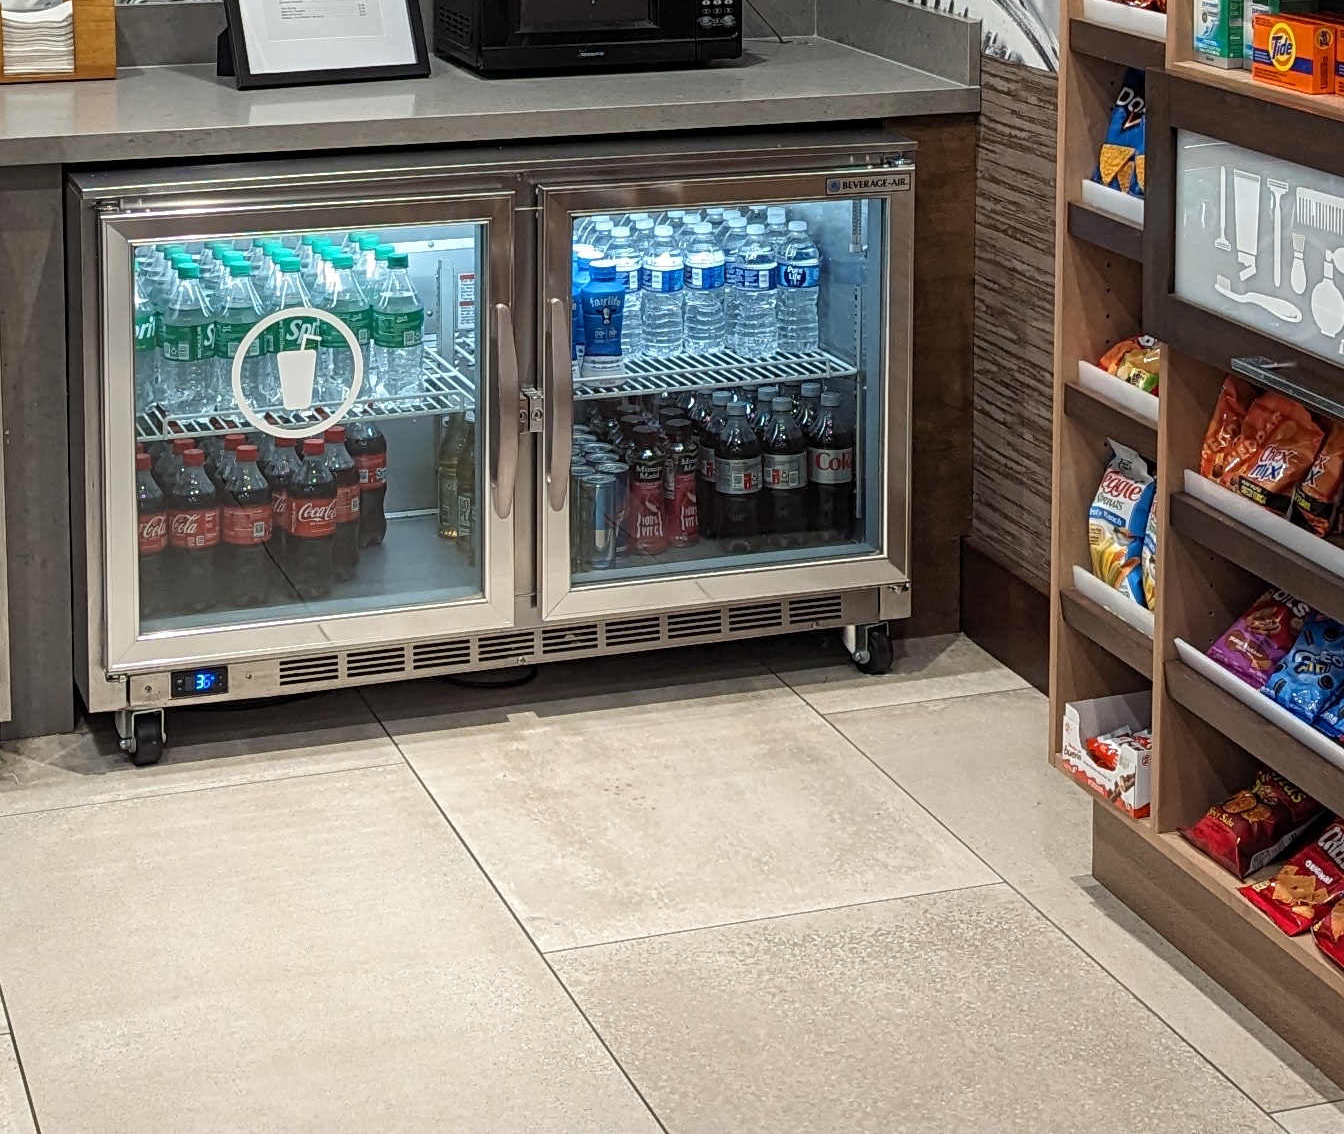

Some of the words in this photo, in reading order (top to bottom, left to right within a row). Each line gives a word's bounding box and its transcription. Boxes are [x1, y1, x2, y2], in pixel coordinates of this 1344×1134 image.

[1271, 34, 1293, 59] Tide
[843, 178, 906, 189] BEVERAGE-AIR
[787, 266, 804, 274] Pure
[789, 272, 802, 280] Life
[590, 297, 622, 307] fairlife
[1258, 445, 1291, 462] Chex
[1064, 745, 1082, 761] bueno
